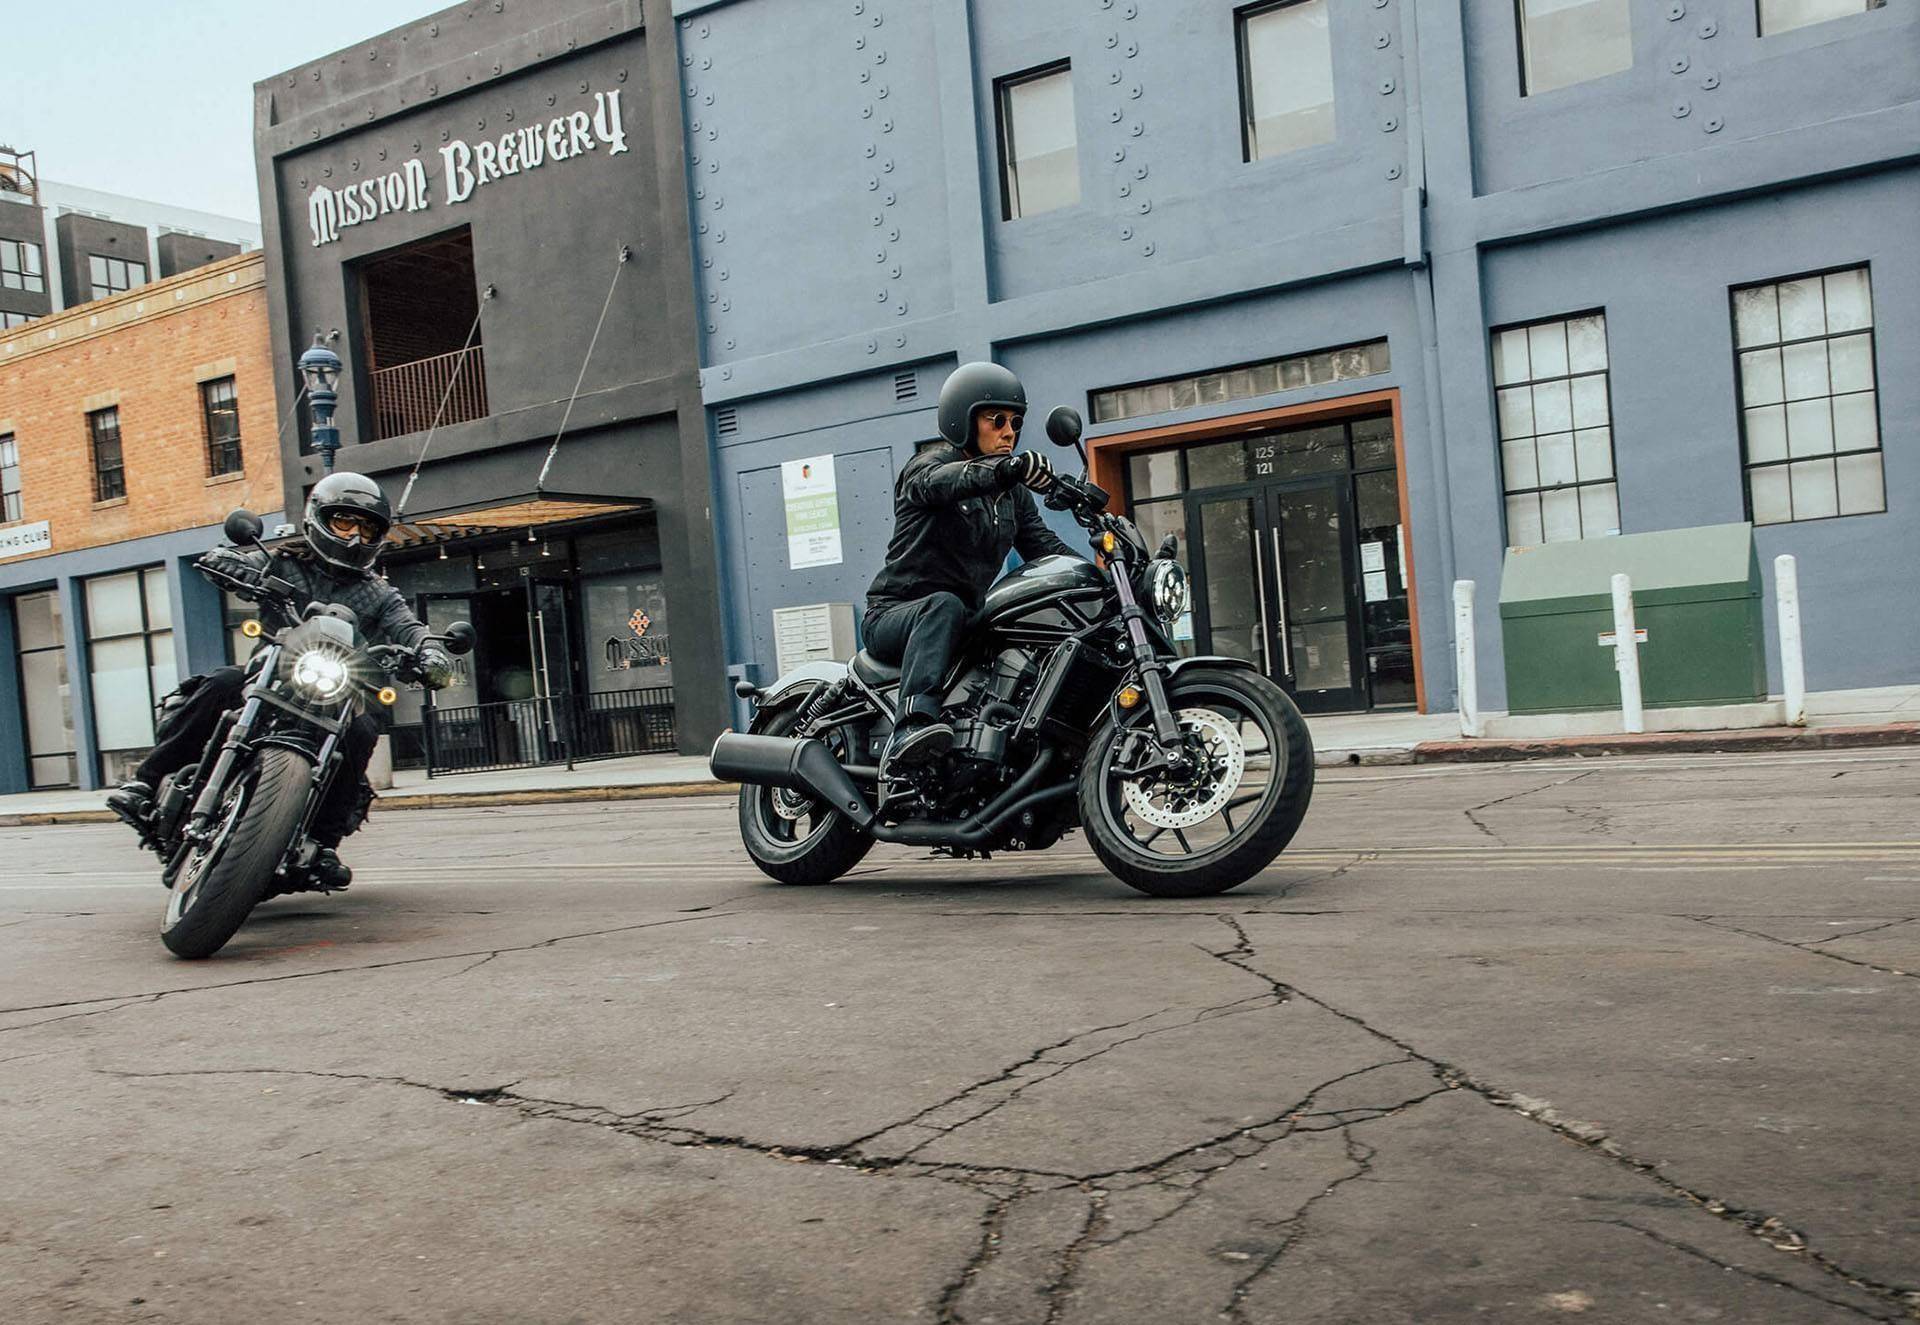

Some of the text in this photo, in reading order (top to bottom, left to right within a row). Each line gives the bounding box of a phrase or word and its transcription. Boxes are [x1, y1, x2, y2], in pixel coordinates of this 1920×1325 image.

[308, 89, 629, 247] MISSION BREWERY
[1255, 445, 1275, 459] 125
[1256, 462, 1274, 475] 121
[23, 530, 49, 545] CLUB
